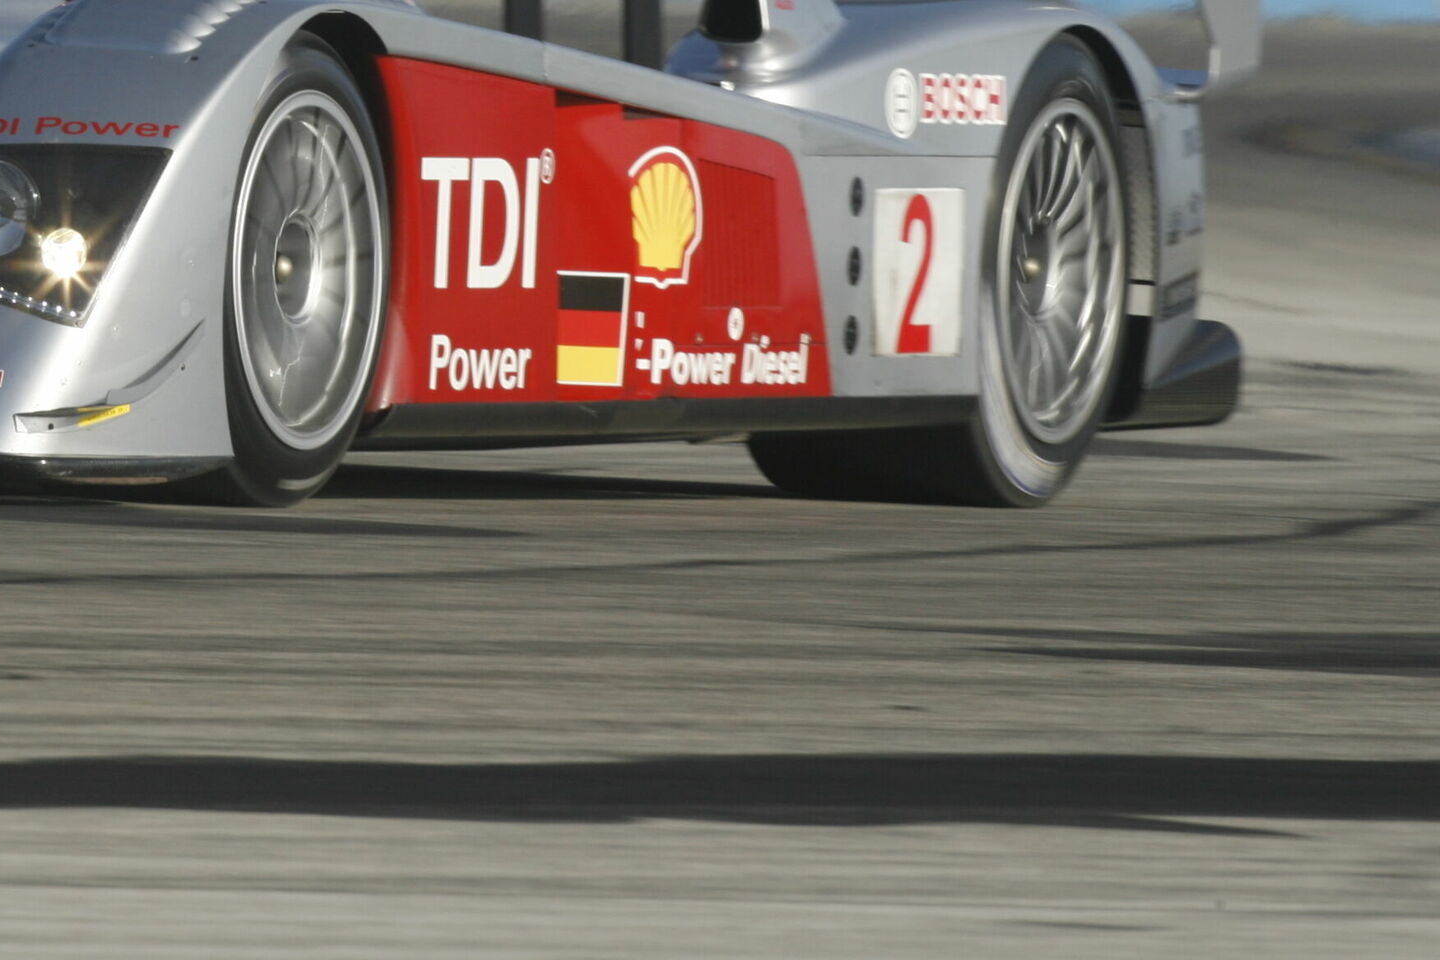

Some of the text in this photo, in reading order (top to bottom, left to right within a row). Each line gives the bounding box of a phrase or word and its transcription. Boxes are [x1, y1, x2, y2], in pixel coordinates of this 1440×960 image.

[918, 72, 1007, 126] BOSCH
[34, 116, 180, 138] Power
[895, 192, 935, 354] 2
[428, 333, 532, 391] Power
[740, 332, 810, 386] Diesel
